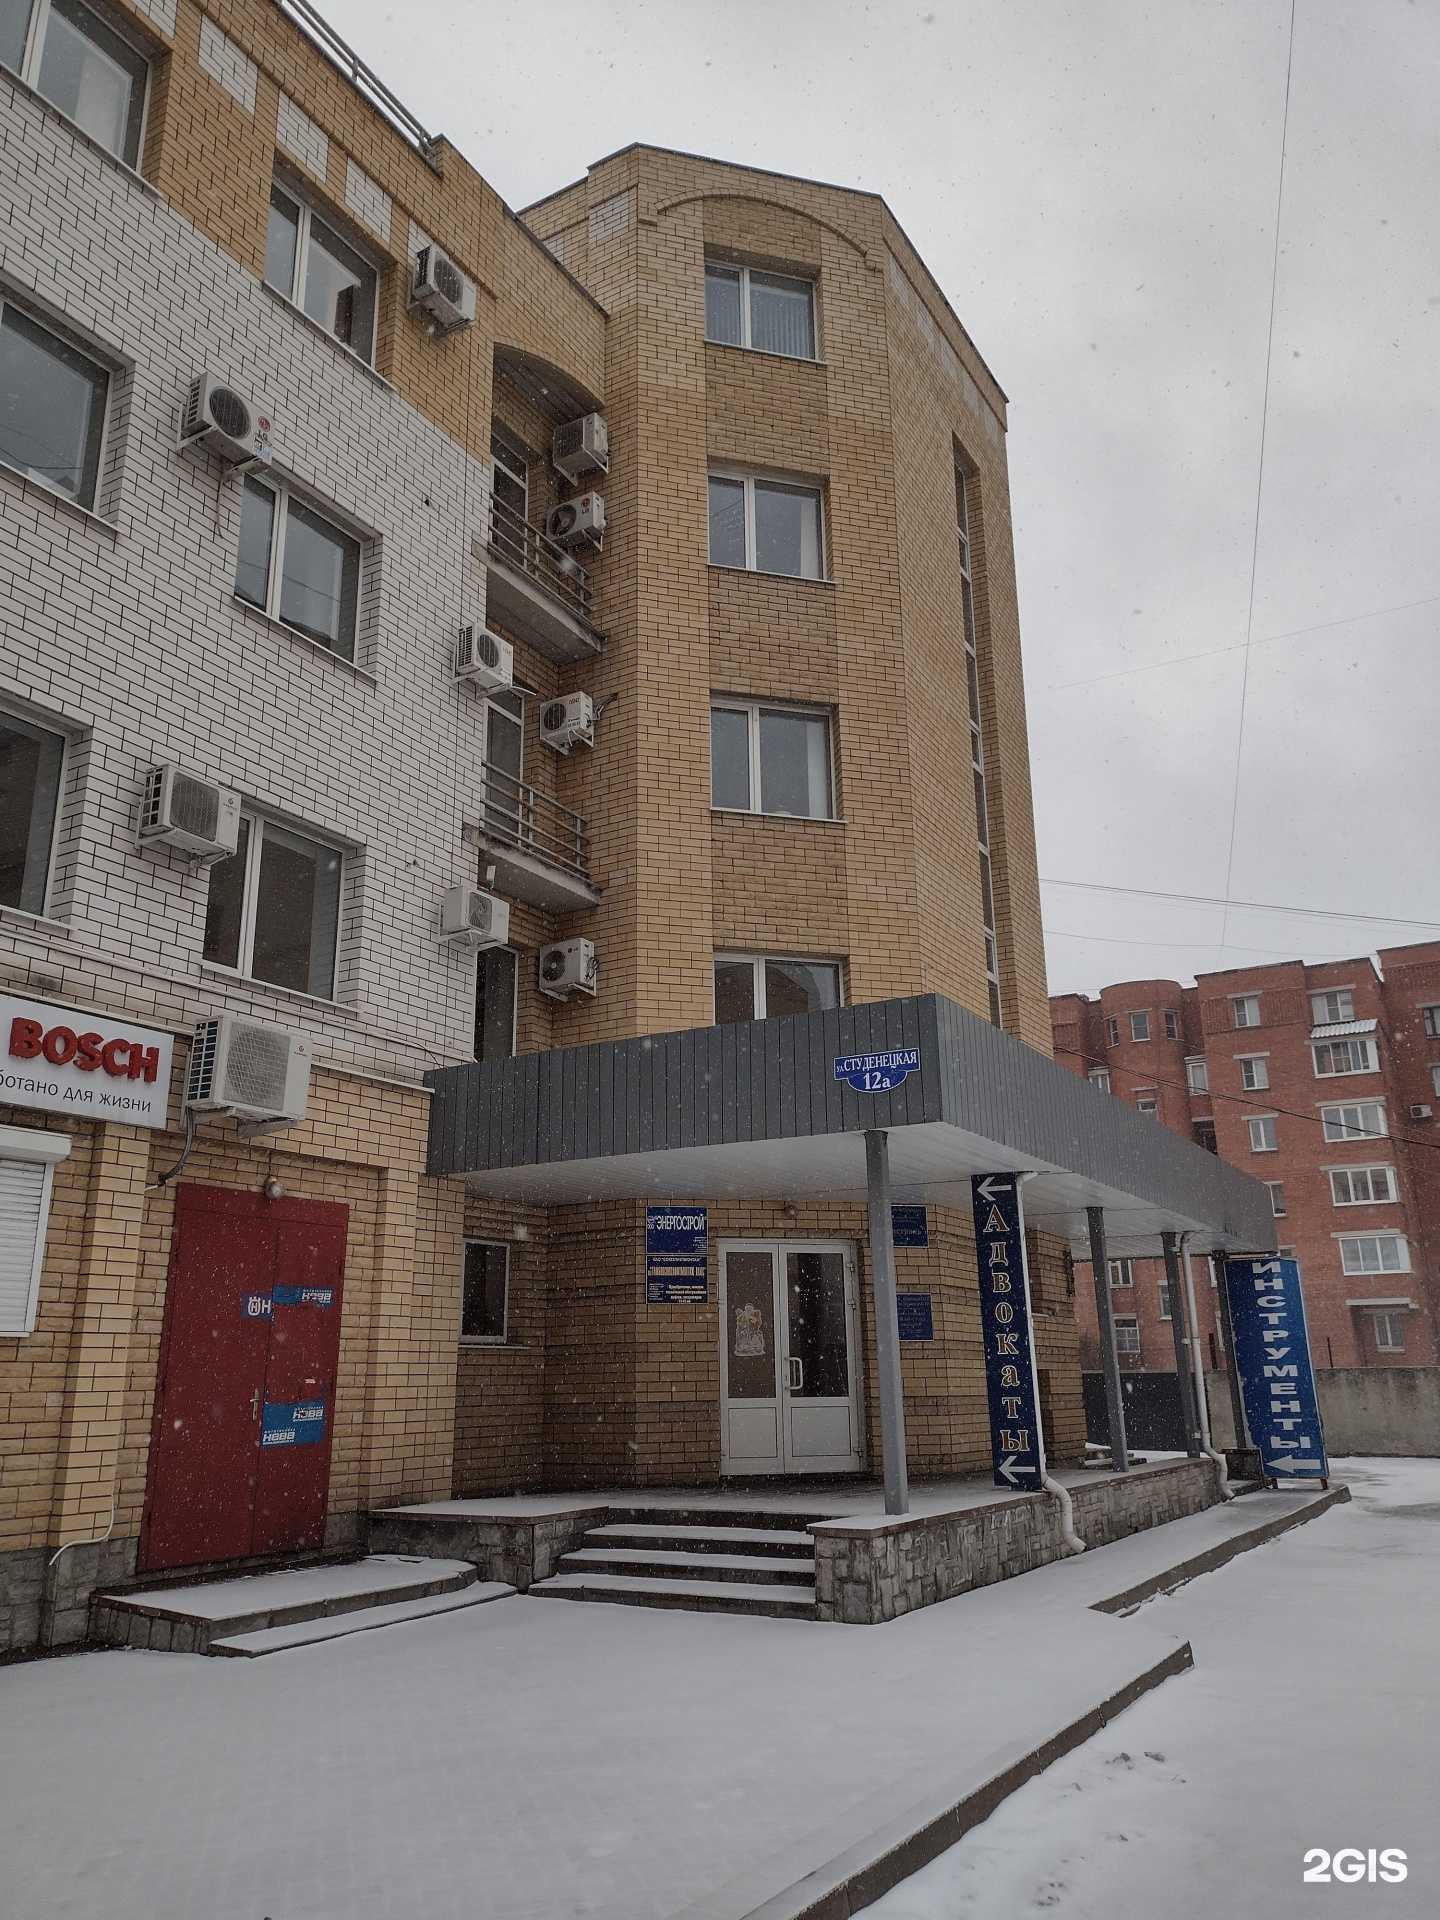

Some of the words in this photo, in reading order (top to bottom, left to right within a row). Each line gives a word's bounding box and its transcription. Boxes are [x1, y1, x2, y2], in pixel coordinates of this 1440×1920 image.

[8, 1016, 160, 1083] BOSCH
[844, 1051, 917, 1072] СТУДЕНЕЦКАЯ
[63, 1086, 94, 1103] для
[99, 1092, 152, 1113] жизни
[1251, 1261, 1311, 1449] ИНСТРУМЕНТЫ
